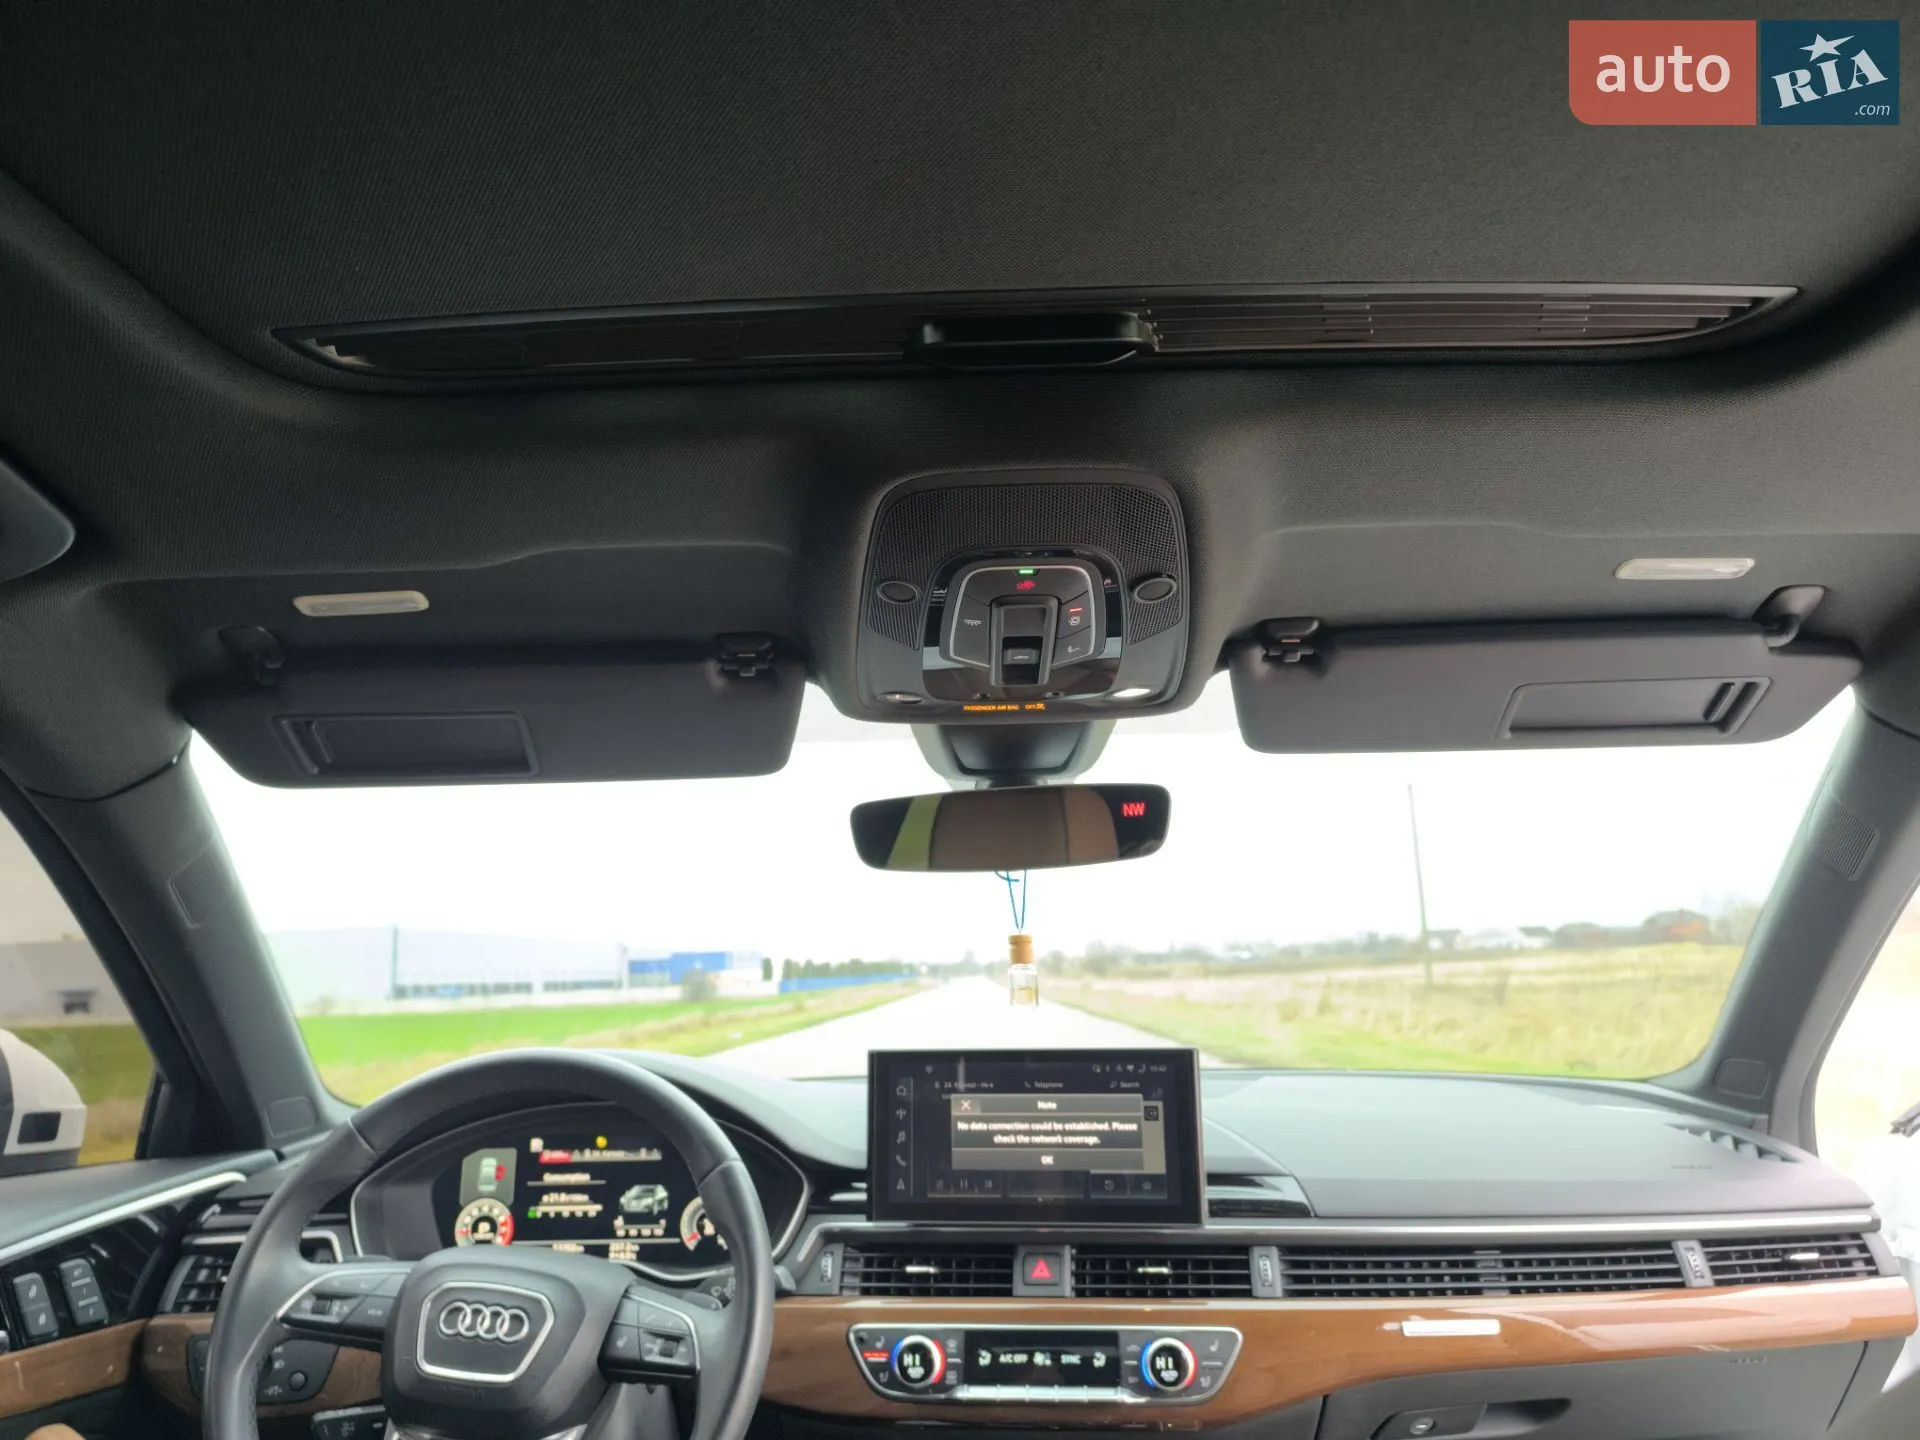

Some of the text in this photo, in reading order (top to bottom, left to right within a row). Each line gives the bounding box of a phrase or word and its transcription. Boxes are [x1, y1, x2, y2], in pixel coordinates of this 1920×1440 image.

[1123, 802, 1145, 817] NW
[1037, 1100, 1057, 1110] Note
[957, 1121, 1138, 1131] No data connection could be established. Please
[994, 1134, 1101, 1146] check the network coverage.
[1041, 1155, 1054, 1165] OK
[903, 1353, 920, 1367] HI
[999, 1353, 1029, 1363] A/C OFF
[1060, 1353, 1081, 1364] SYNC
[1155, 1356, 1174, 1370] HI
